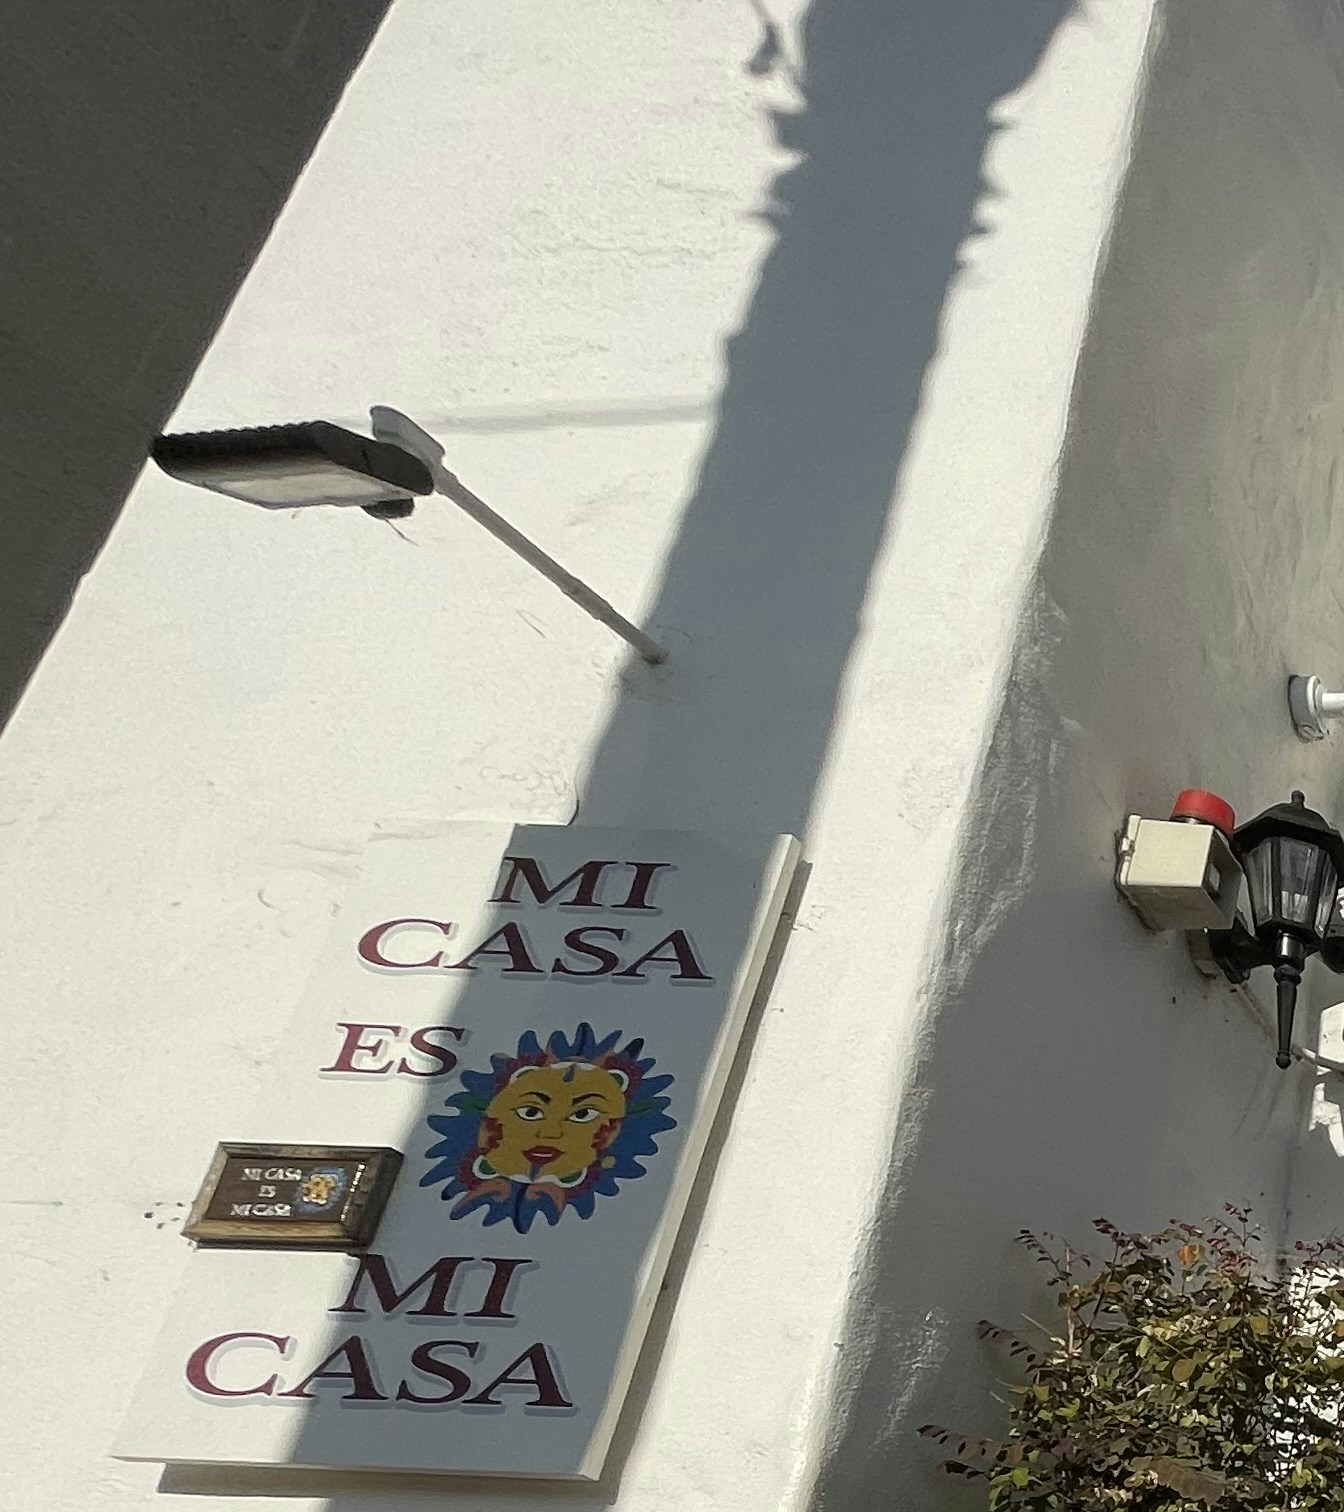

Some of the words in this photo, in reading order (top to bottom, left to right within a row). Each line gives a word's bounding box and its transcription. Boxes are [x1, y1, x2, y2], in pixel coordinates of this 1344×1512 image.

[487, 855, 675, 914] MI
[357, 917, 717, 985] CASA
[319, 1021, 467, 1079] ES
[327, 1252, 538, 1324] MI
[186, 1331, 577, 1414] CASA
